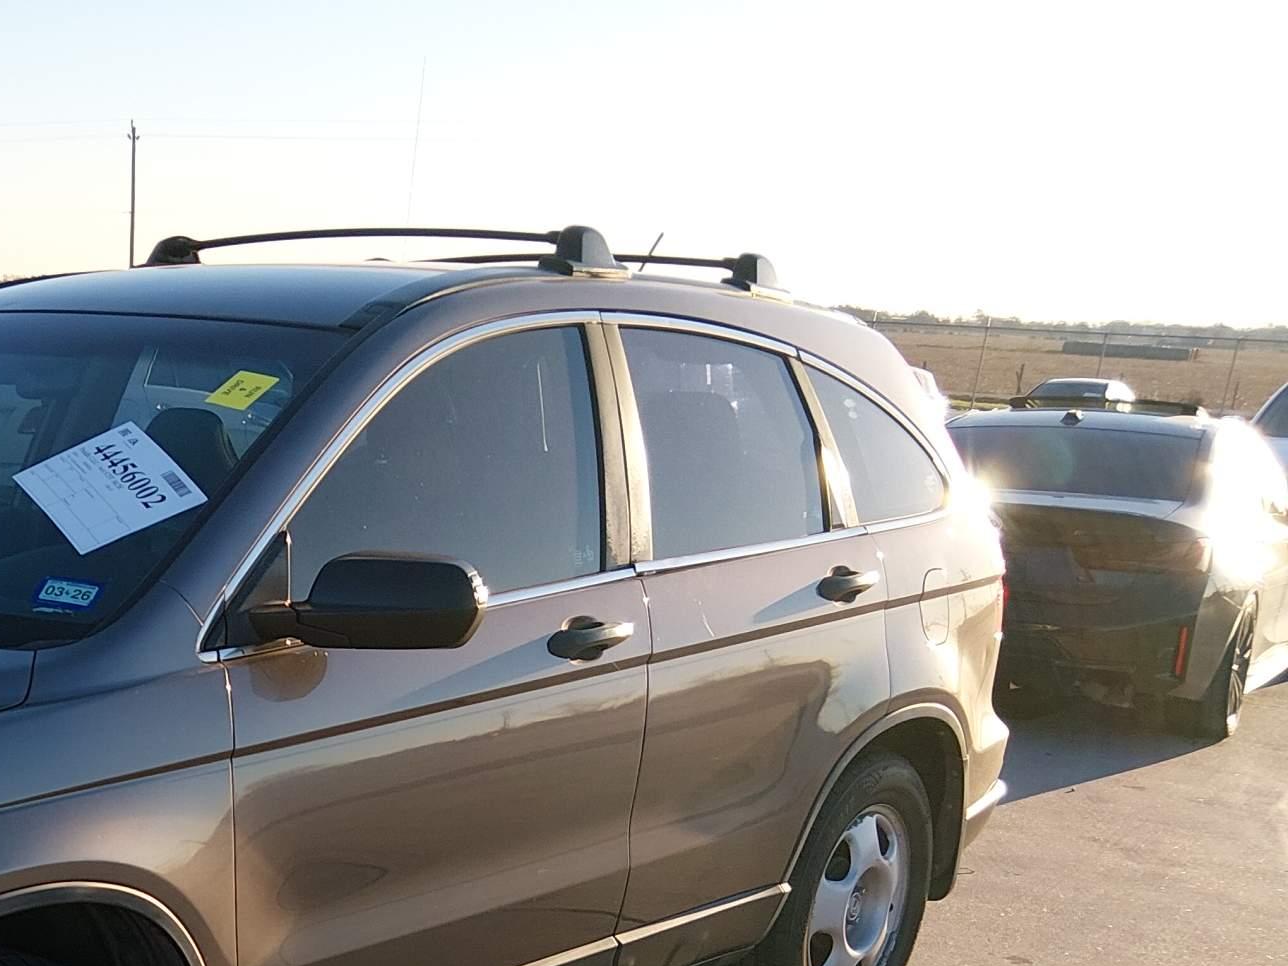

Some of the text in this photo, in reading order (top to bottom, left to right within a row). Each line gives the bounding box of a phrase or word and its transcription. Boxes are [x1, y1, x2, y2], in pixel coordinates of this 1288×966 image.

[94, 444, 167, 509] 44456002
[43, 584, 93, 601] 03 26
